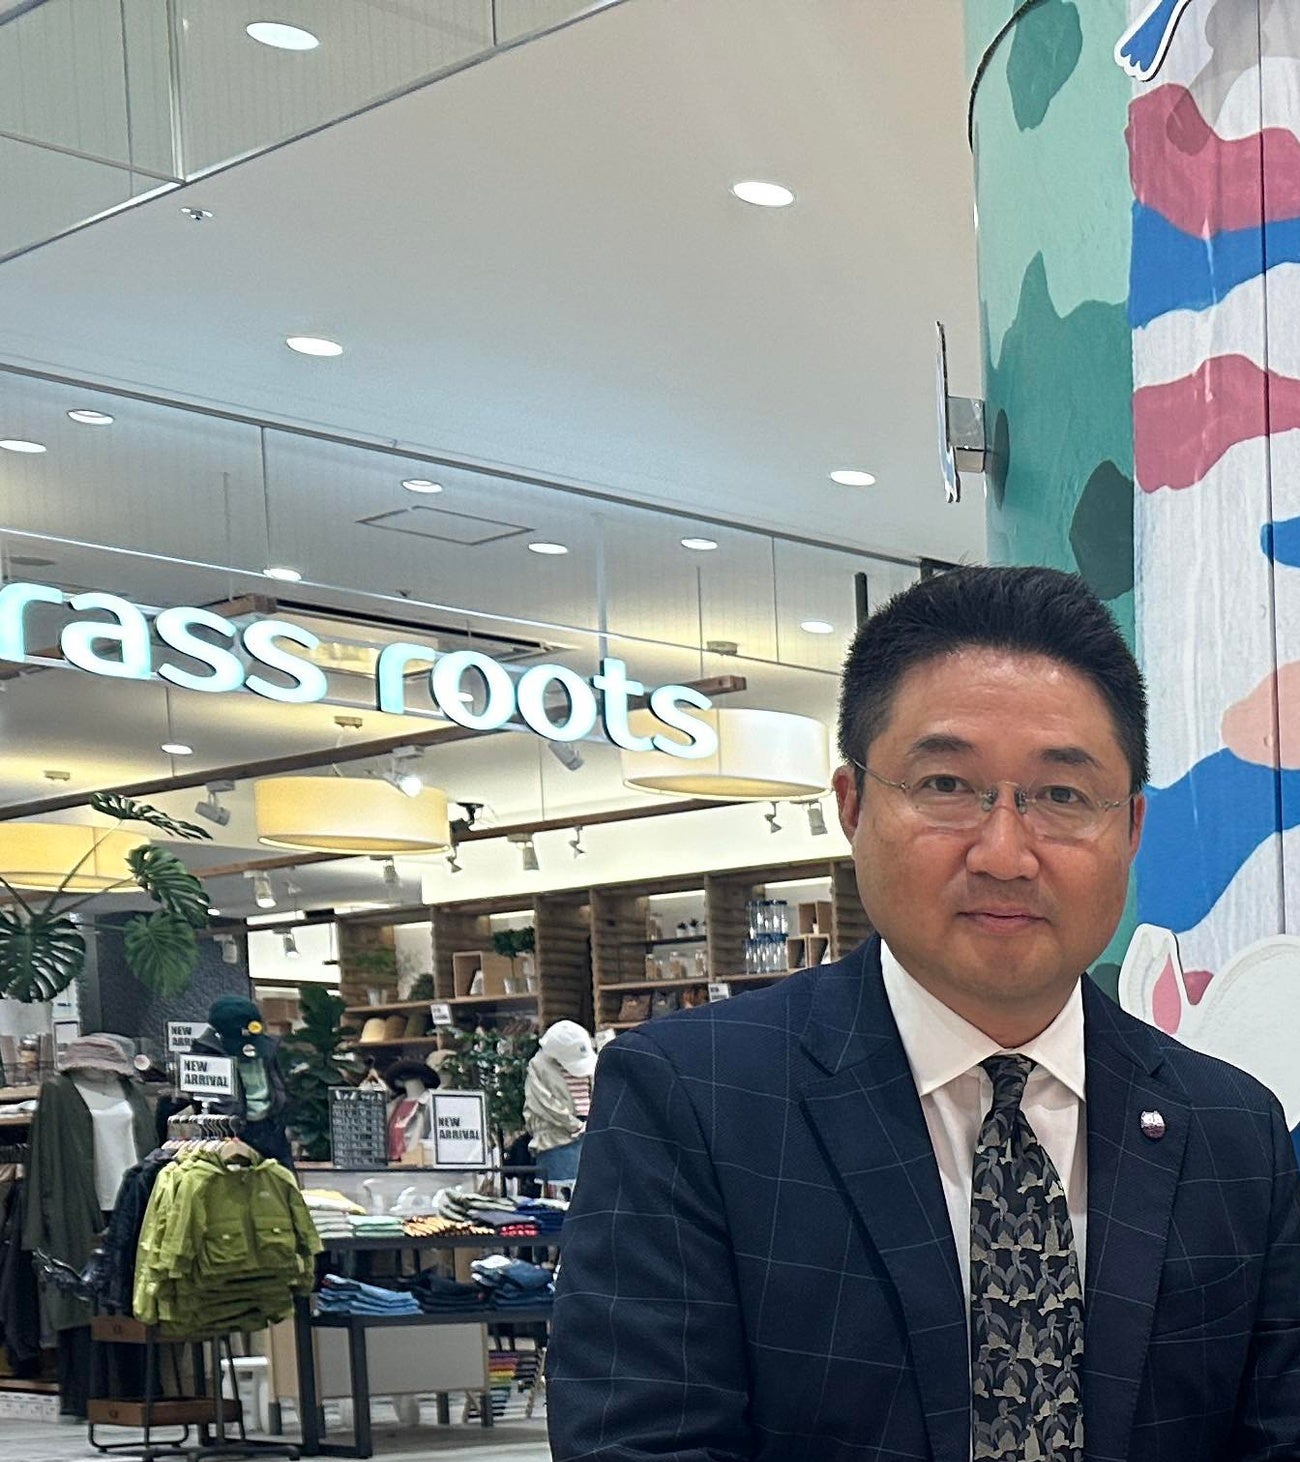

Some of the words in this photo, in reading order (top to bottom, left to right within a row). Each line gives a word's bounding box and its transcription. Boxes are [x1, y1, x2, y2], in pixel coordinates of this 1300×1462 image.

[0, 583, 328, 703] rass
[377, 642, 719, 760] roots
[171, 1026, 192, 1036] NEW
[184, 1060, 208, 1072] NEW
[185, 1074, 229, 1088] ARRIVAL
[438, 1117, 461, 1127] NEW
[439, 1129, 480, 1140] ARRIVAL
